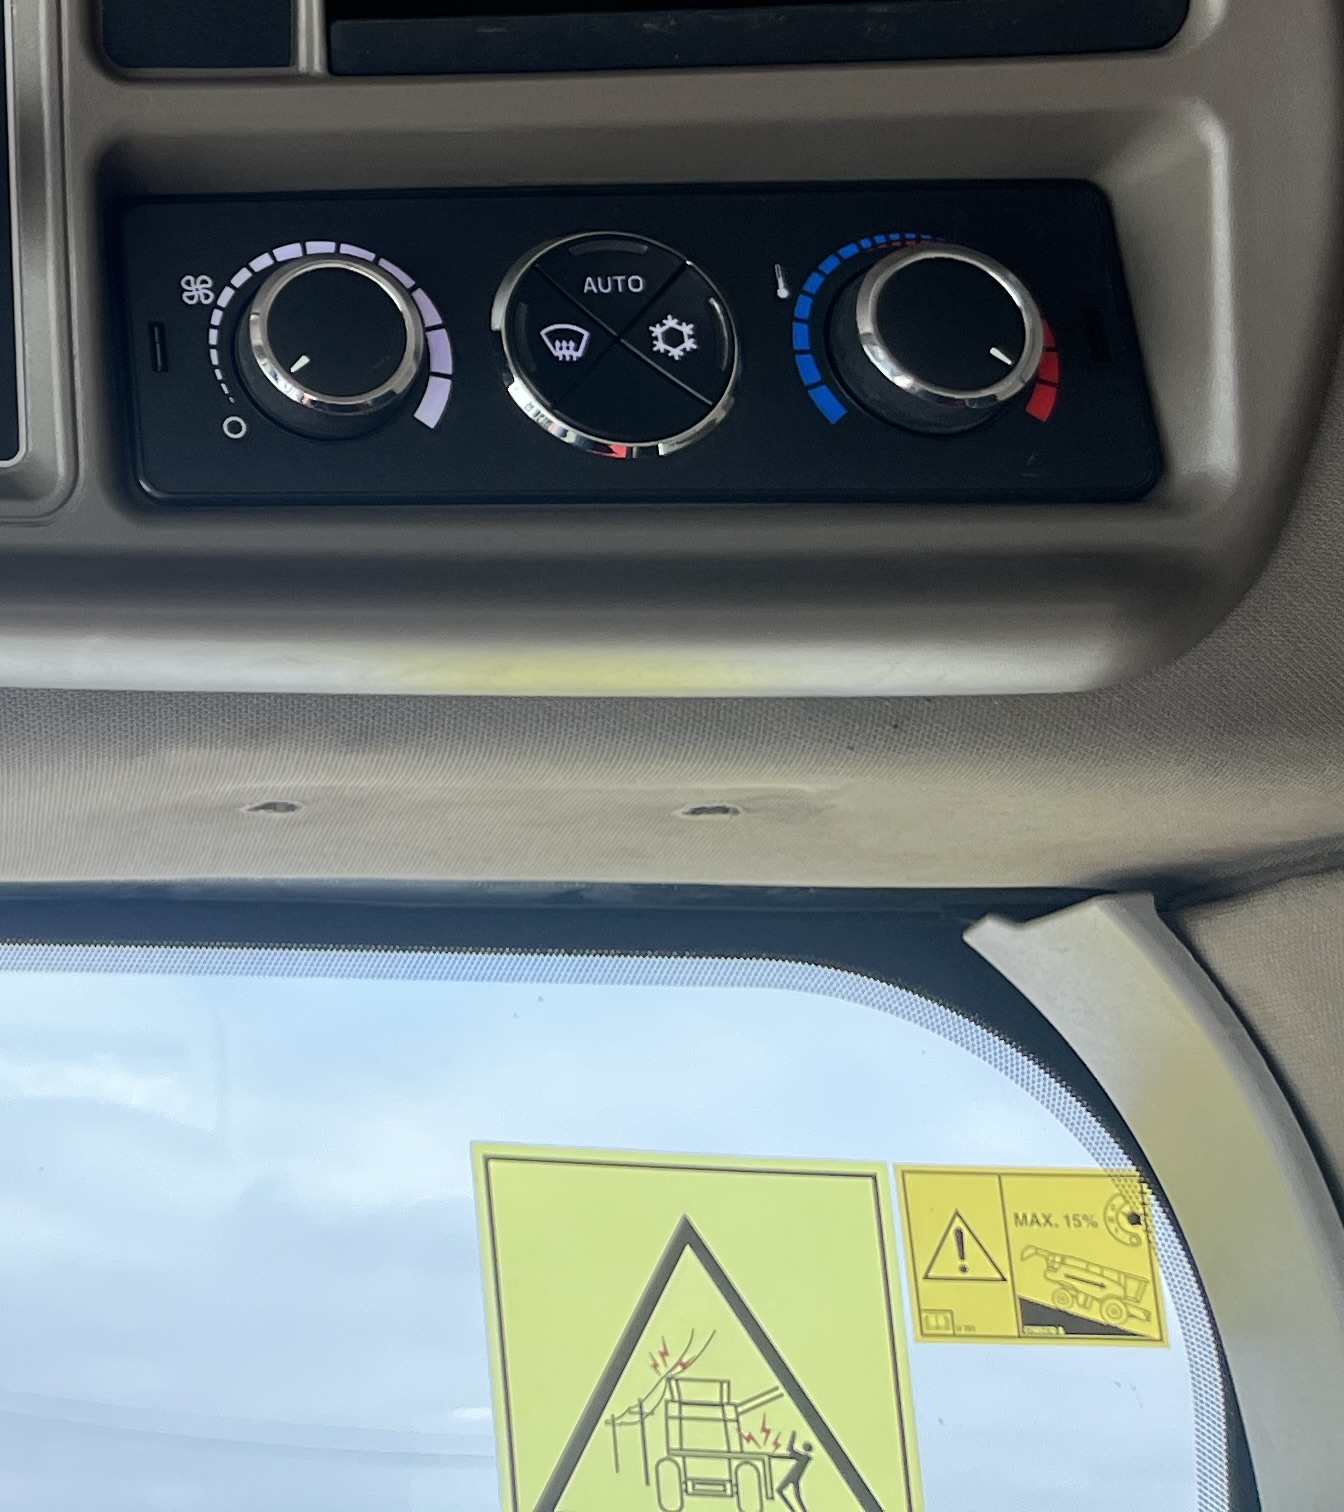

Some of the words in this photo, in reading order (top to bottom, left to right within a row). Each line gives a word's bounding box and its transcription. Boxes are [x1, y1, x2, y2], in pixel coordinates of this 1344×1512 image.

[583, 275, 644, 294] AUTO
[1013, 1212, 1060, 1229] MAX.
[1063, 1213, 1099, 1229] 15%
